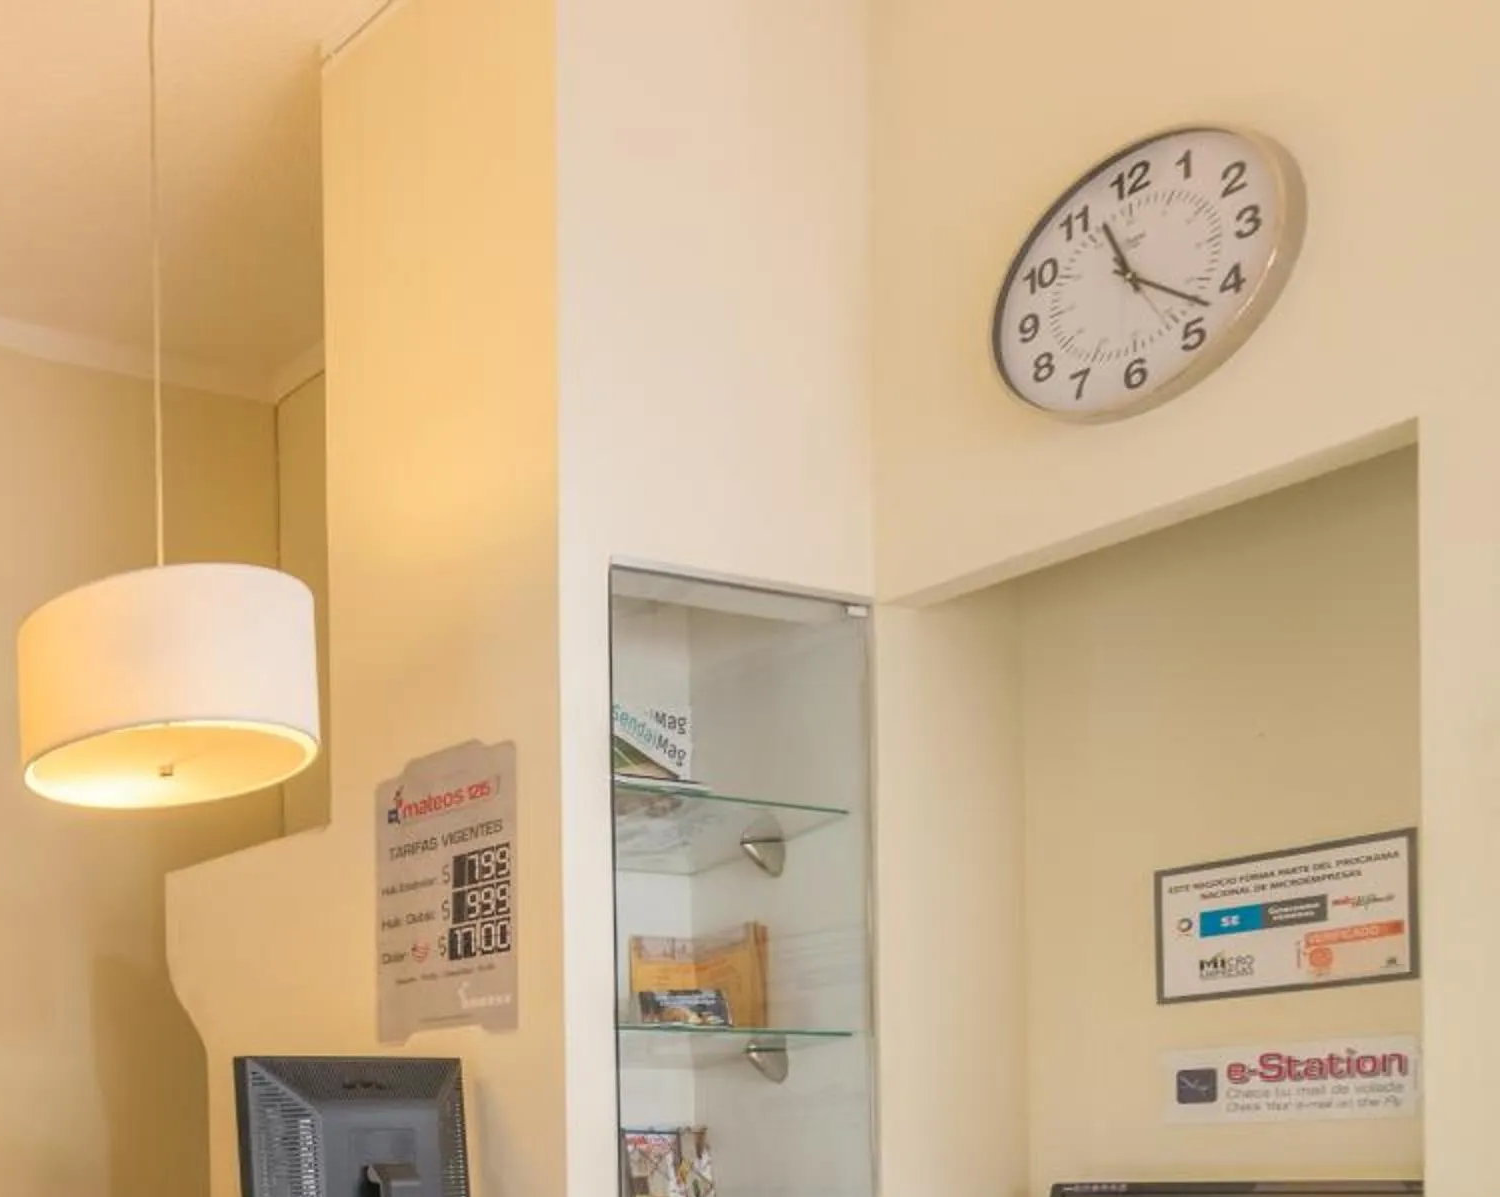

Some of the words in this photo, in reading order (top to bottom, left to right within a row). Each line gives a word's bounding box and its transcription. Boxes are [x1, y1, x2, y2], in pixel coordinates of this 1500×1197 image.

[1110, 159, 1152, 201] 12
[1175, 148, 1194, 180] 1
[1219, 160, 1248, 198] 2
[1059, 204, 1090, 242] 11
[1233, 203, 1263, 240] 3
[1022, 256, 1059, 295] 10
[1218, 262, 1247, 294] 4
[1018, 312, 1040, 344] 9
[1180, 316, 1207, 351] 5
[1031, 351, 1056, 383] 8
[1069, 367, 1092, 401] 7
[1123, 357, 1148, 390] 6
[402, 789, 463, 819] mateos
[389, 835, 438, 861] TARIFAS
[441, 818, 503, 848] VIGENTES
[466, 845, 510, 880] 799
[1312, 860, 1332, 871] DEL
[1225, 1048, 1409, 1085] e-Station
